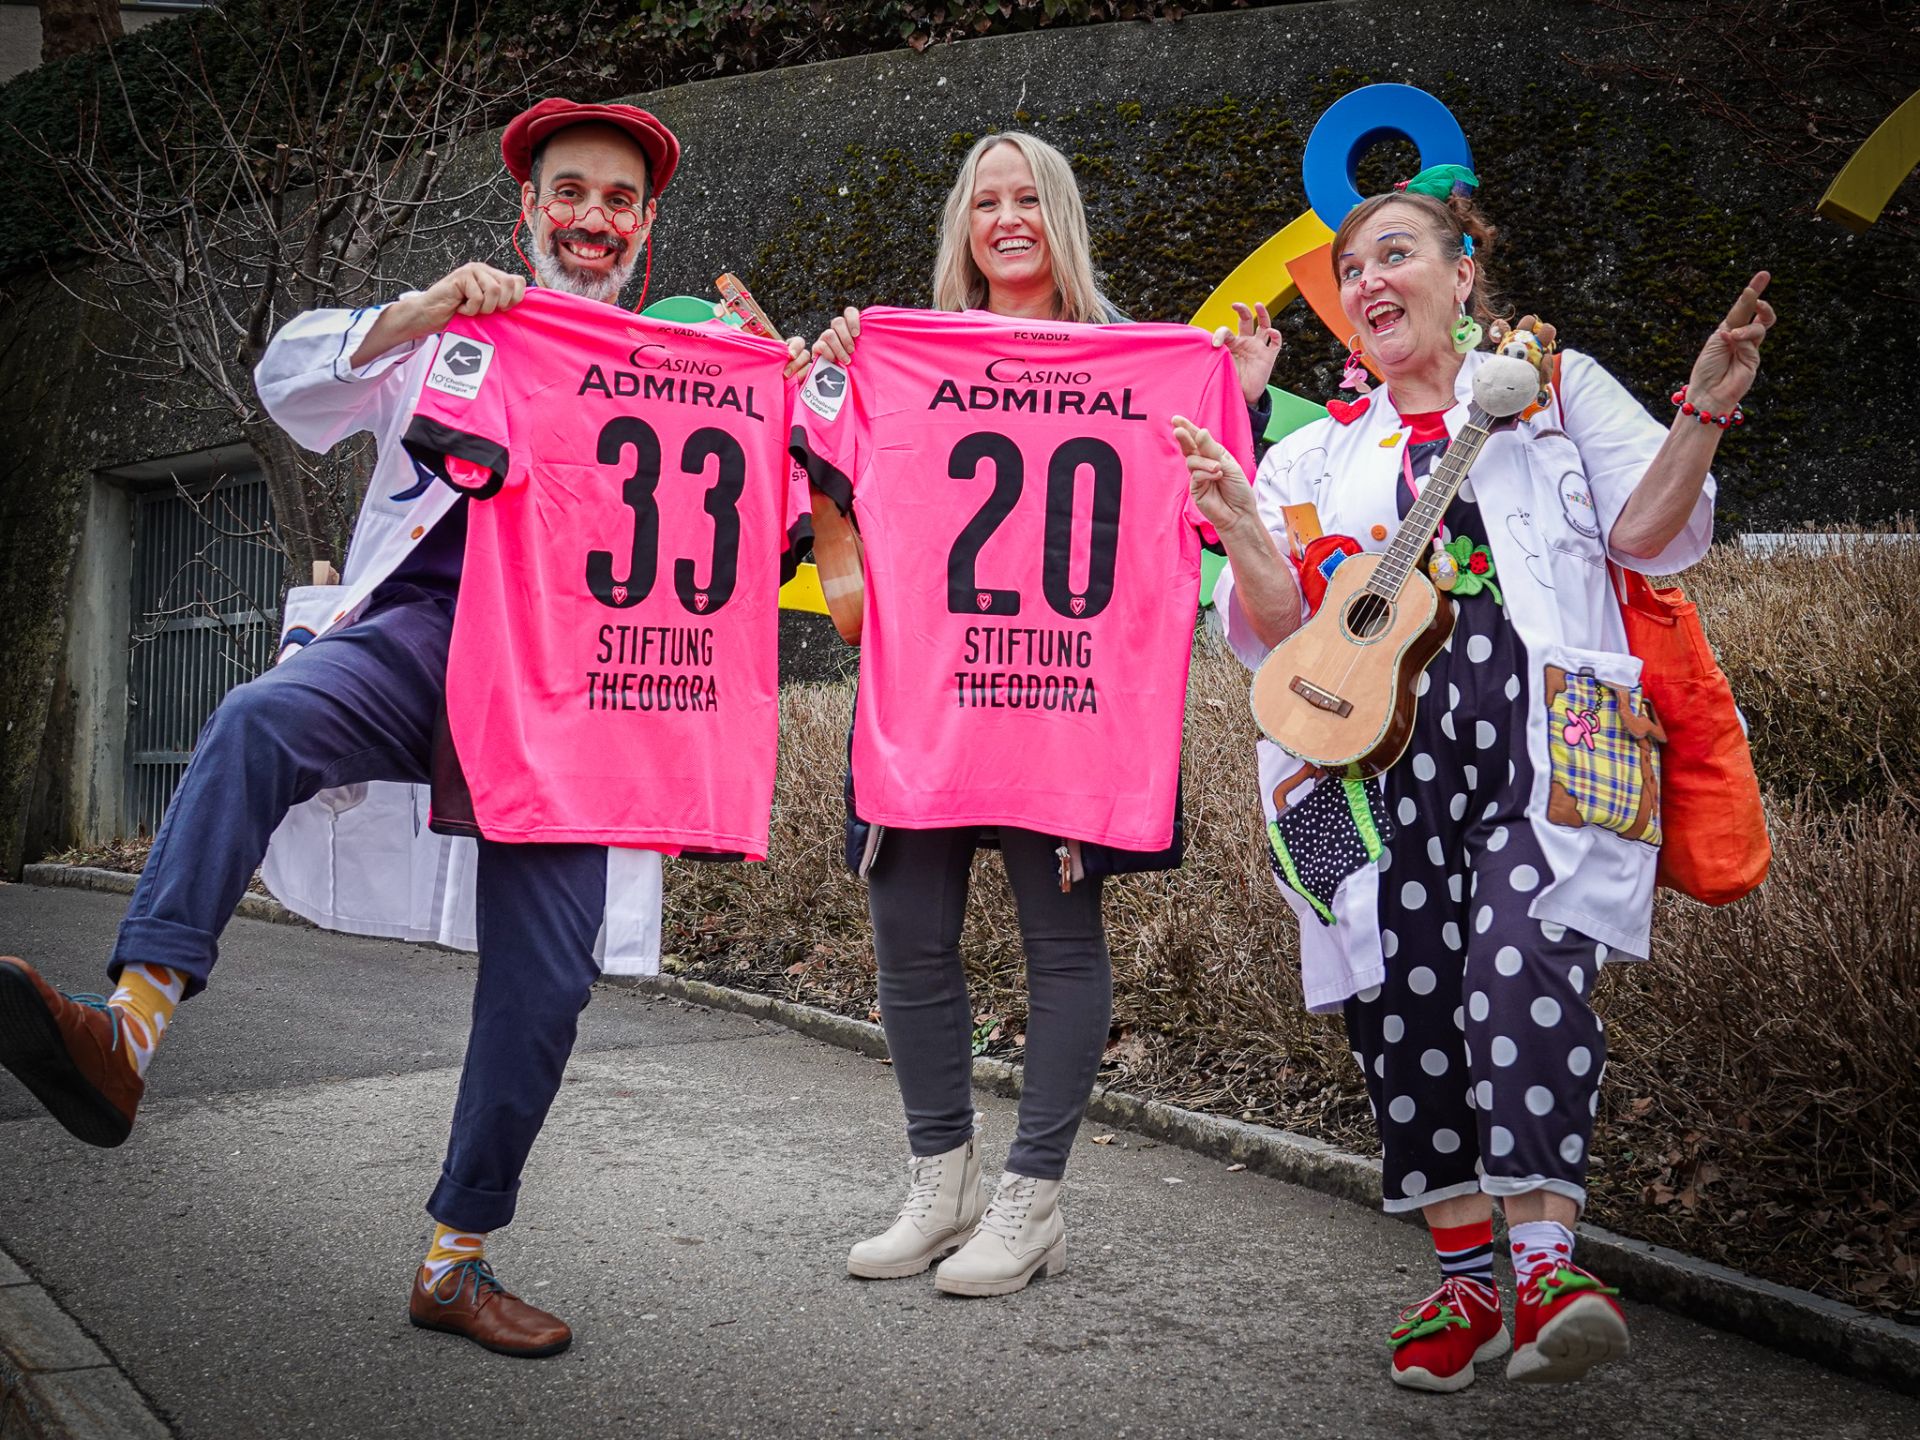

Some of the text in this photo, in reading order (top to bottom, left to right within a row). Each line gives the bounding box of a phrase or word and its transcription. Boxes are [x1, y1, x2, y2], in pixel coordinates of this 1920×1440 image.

[1014, 331, 1070, 342] FC VADUZ
[629, 344, 723, 377] CASINO
[985, 357, 1092, 385] CASINO
[577, 364, 765, 422] ADMIRAL
[928, 379, 1147, 420] ADMIRAL
[586, 416, 746, 615] 33
[947, 431, 1123, 619] 20
[596, 624, 714, 667] STIFTUNG
[964, 626, 1092, 668] STIFTUNG
[586, 671, 718, 712] THEODORA
[954, 672, 1098, 714] THEODORA
